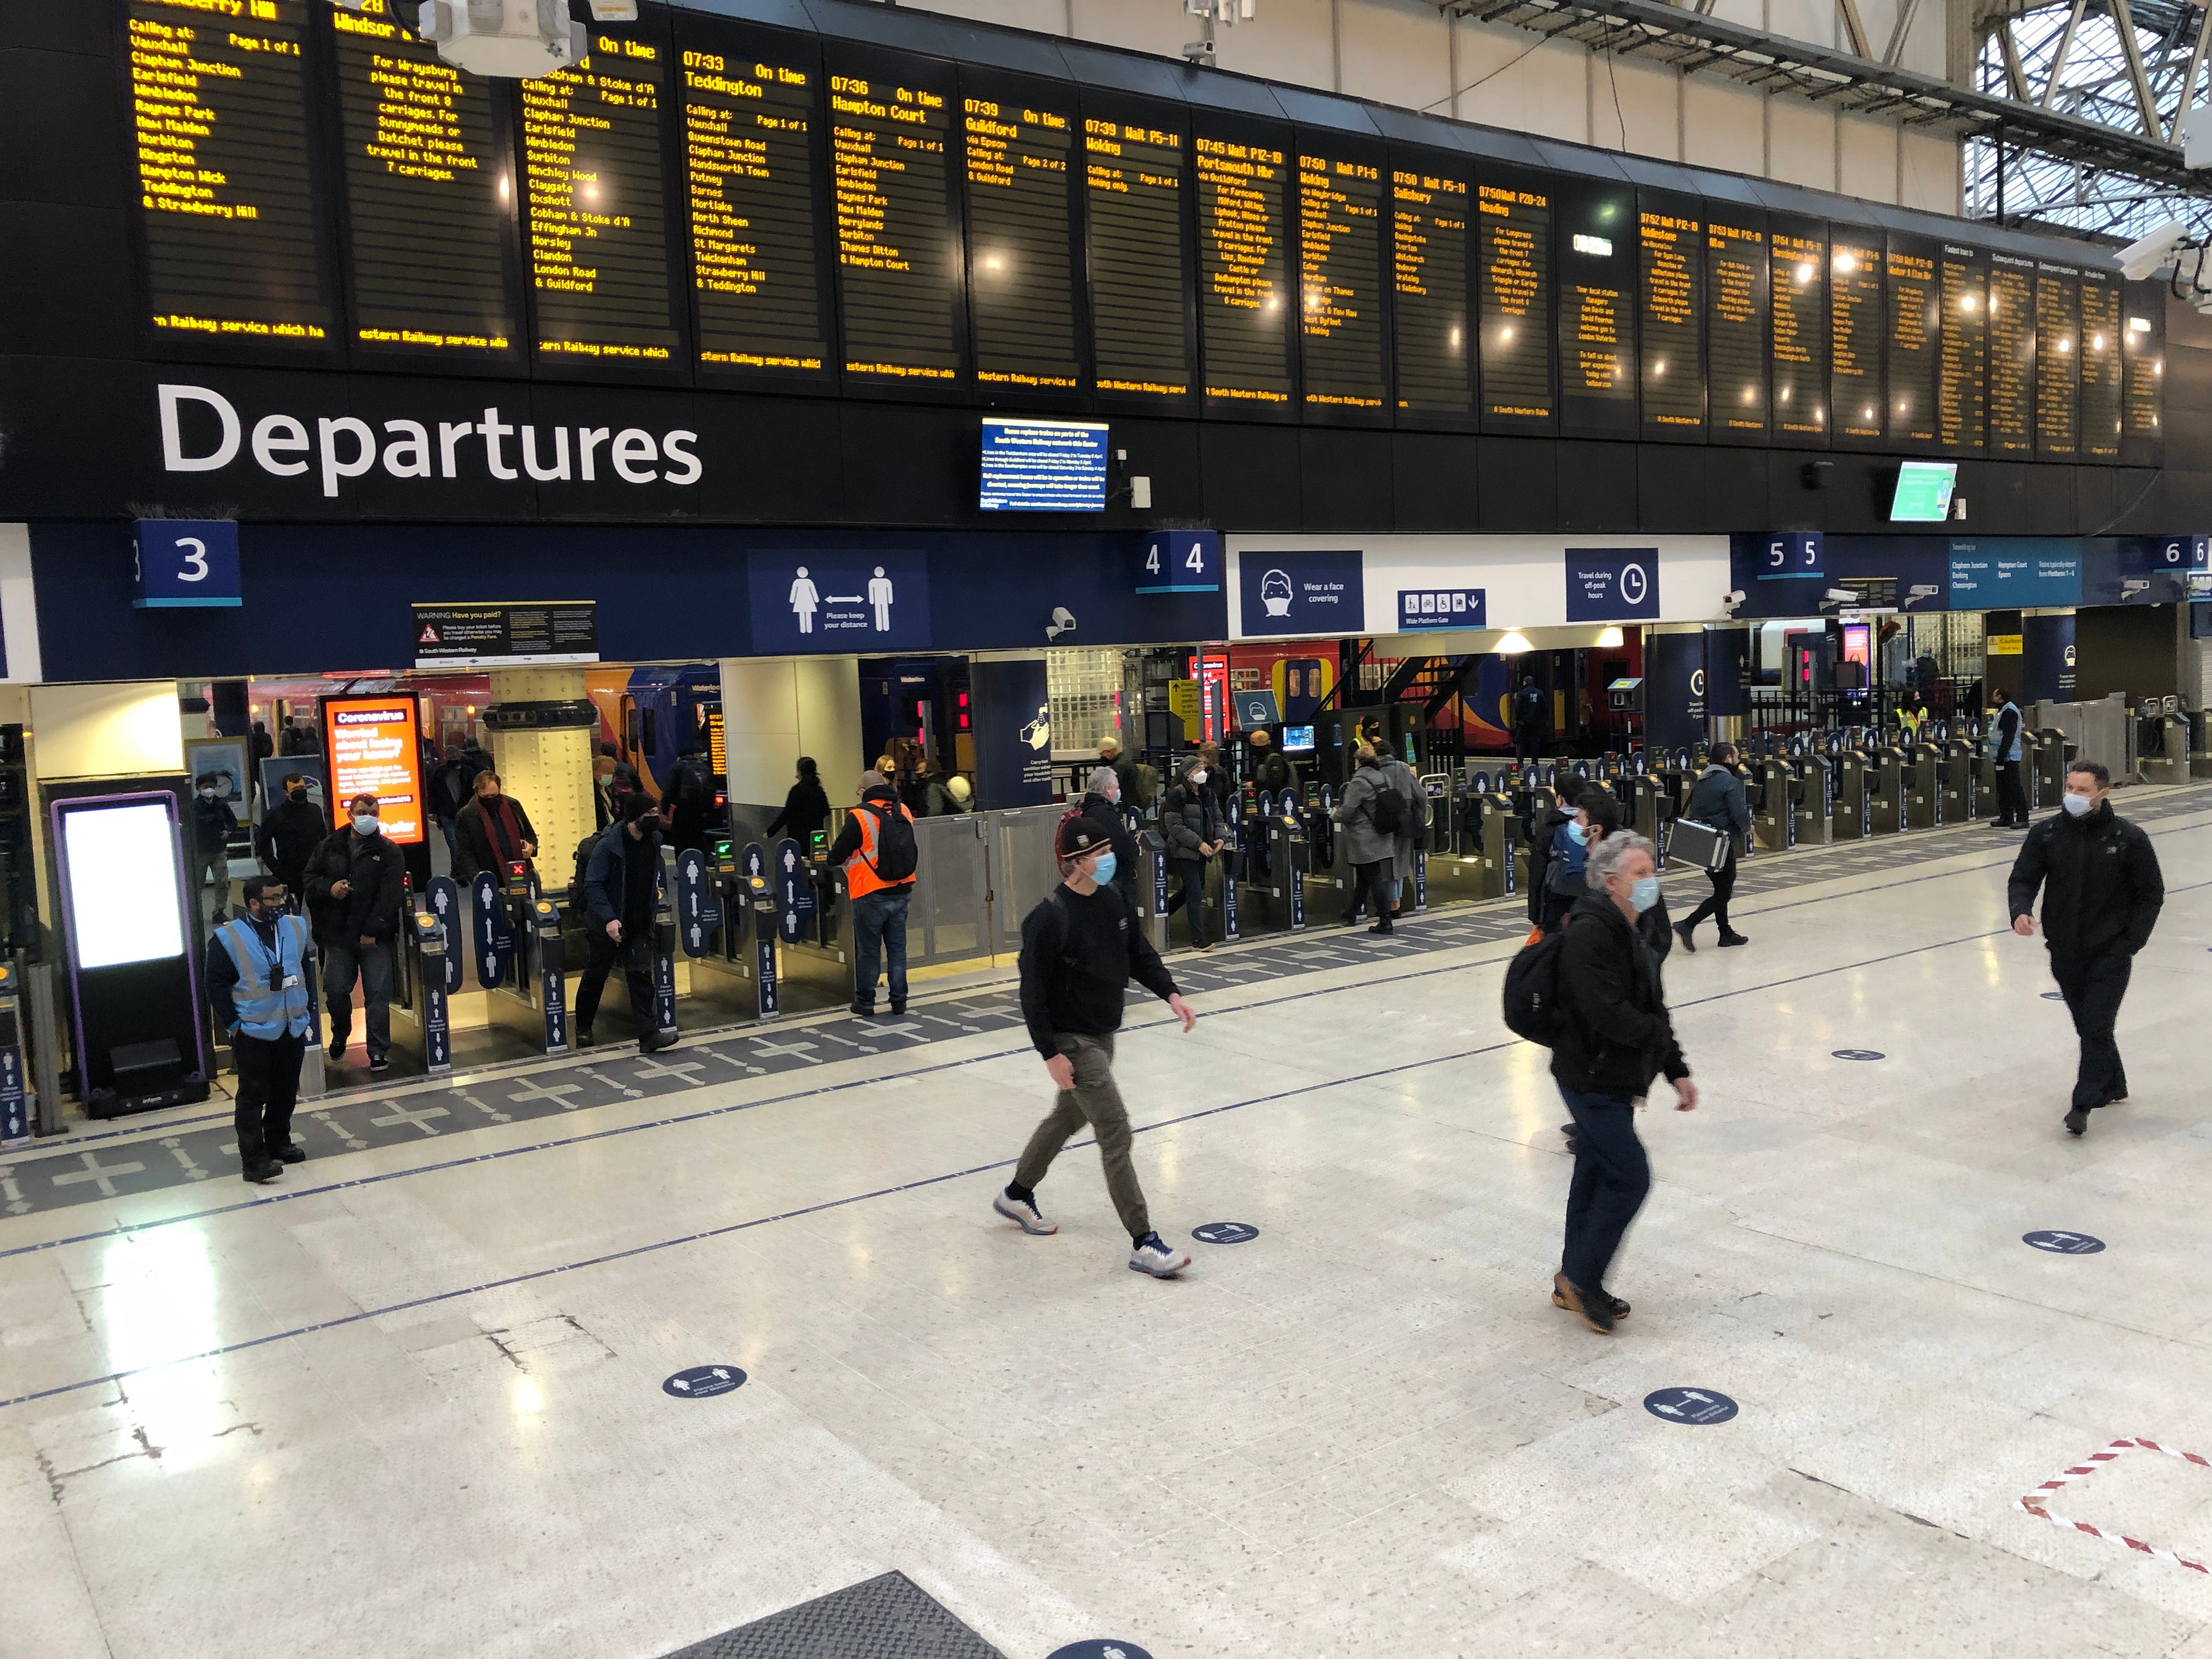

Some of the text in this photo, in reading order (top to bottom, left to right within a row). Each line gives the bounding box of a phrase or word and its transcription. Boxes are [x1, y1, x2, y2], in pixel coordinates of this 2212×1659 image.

[251, 0, 276, 20] Hill
[334, 12, 395, 37] Windsor
[129, 19, 300, 55] Calling at: Page 1 of 1
[131, 36, 188, 54] Vauxhall
[600, 36, 654, 59] On time
[132, 52, 241, 77] Clapham Junction
[374, 55, 457, 81] For Wraysbury
[684, 51, 805, 84] 07:33 On time
[133, 67, 198, 87] Earlsfield
[371, 72, 462, 94] please travel in
[686, 72, 761, 96] Teddington
[134, 84, 197, 103] Wimbledon
[384, 87, 452, 107] the front 8
[832, 76, 942, 107] 07:36 On time
[136, 99, 215, 120] Raynes Park
[379, 103, 458, 122] carriages. For
[833, 96, 924, 123] Hampton Court
[965, 99, 1064, 128] 07:39 On time
[137, 116, 210, 135] New Malden
[966, 118, 1017, 138] Guildford
[1086, 120, 1177, 145] 07:39 Wait P5-11
[138, 132, 194, 149] Norbiton
[967, 136, 1007, 149] via Epsom
[1087, 138, 1120, 155] Woking
[139, 148, 195, 165] Kingston
[140, 164, 225, 184] Hampton Wick
[690, 171, 722, 186] Putney
[143, 180, 213, 199] Teddington
[529, 179, 573, 194] Claygate
[691, 184, 723, 198] Barnes
[143, 195, 256, 218] & Strawberry Hill
[530, 193, 571, 206] Oxshott
[692, 199, 732, 212] Mortlake
[693, 225, 733, 239] Richmond
[839, 216, 883, 230] Berrylands
[532, 235, 571, 250] Horsley
[696, 251, 746, 266] Twickenham
[535, 277, 592, 291] & Guildford
[158, 384, 702, 496] Departures
[133, 539, 141, 582] 3
[175, 538, 208, 582] 3
[1146, 544, 1160, 575] 4
[1186, 543, 1204, 573] 4
[1770, 543, 1784, 567] 5
[1805, 541, 1815, 565] 5
[2166, 543, 2180, 562] 6
[2197, 543, 2204, 561] 6
[1594, 572, 1612, 580] during
[1329, 582, 1344, 590] face
[1585, 582, 1606, 590] off-peak
[1308, 594, 1339, 604] covering
[483, 611, 501, 619] paid?
[337, 711, 404, 723] Coronavirus
